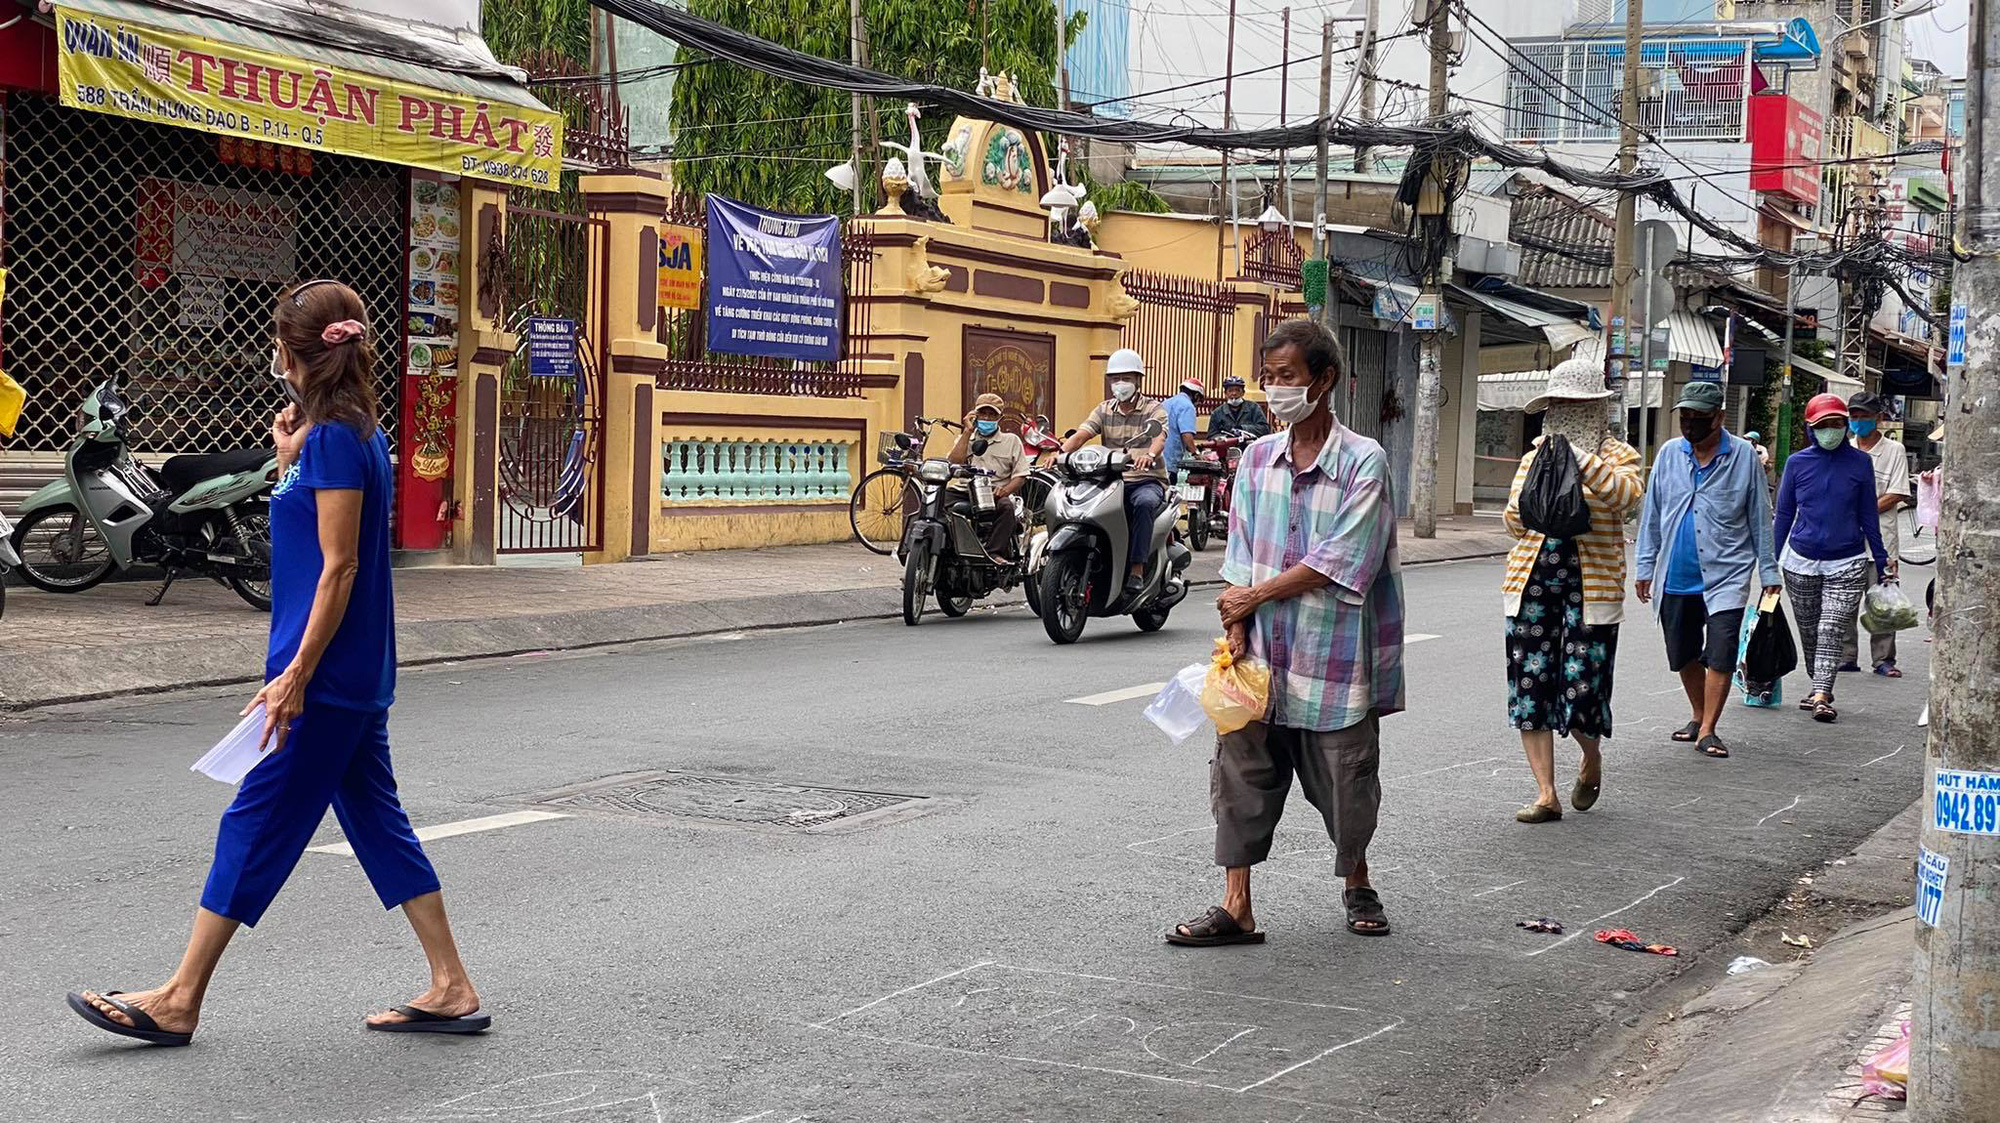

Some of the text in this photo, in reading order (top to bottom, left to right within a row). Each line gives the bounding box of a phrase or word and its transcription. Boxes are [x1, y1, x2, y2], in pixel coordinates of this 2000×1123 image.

[116, 22, 140, 64] ĂN
[77, 84, 105, 105] 588
[111, 87, 151, 114] TRẦN
[157, 102, 200, 124] HƯNG
[206, 110, 237, 134] ĐẠO
[241, 116, 250, 131] B
[263, 119, 289, 139] P.14
[302, 128, 323, 146] Q.5
[176, 49, 529, 155] THUẬN PHÁT
[534, 125, 553, 158] 發
[462, 156, 480, 173] ĐT:
[484, 160, 509, 177] 0938
[532, 169, 549, 185] 628
[534, 321, 569, 333] THÔNG BÁO
[1937, 772, 2000, 791] HÚT HẦM
